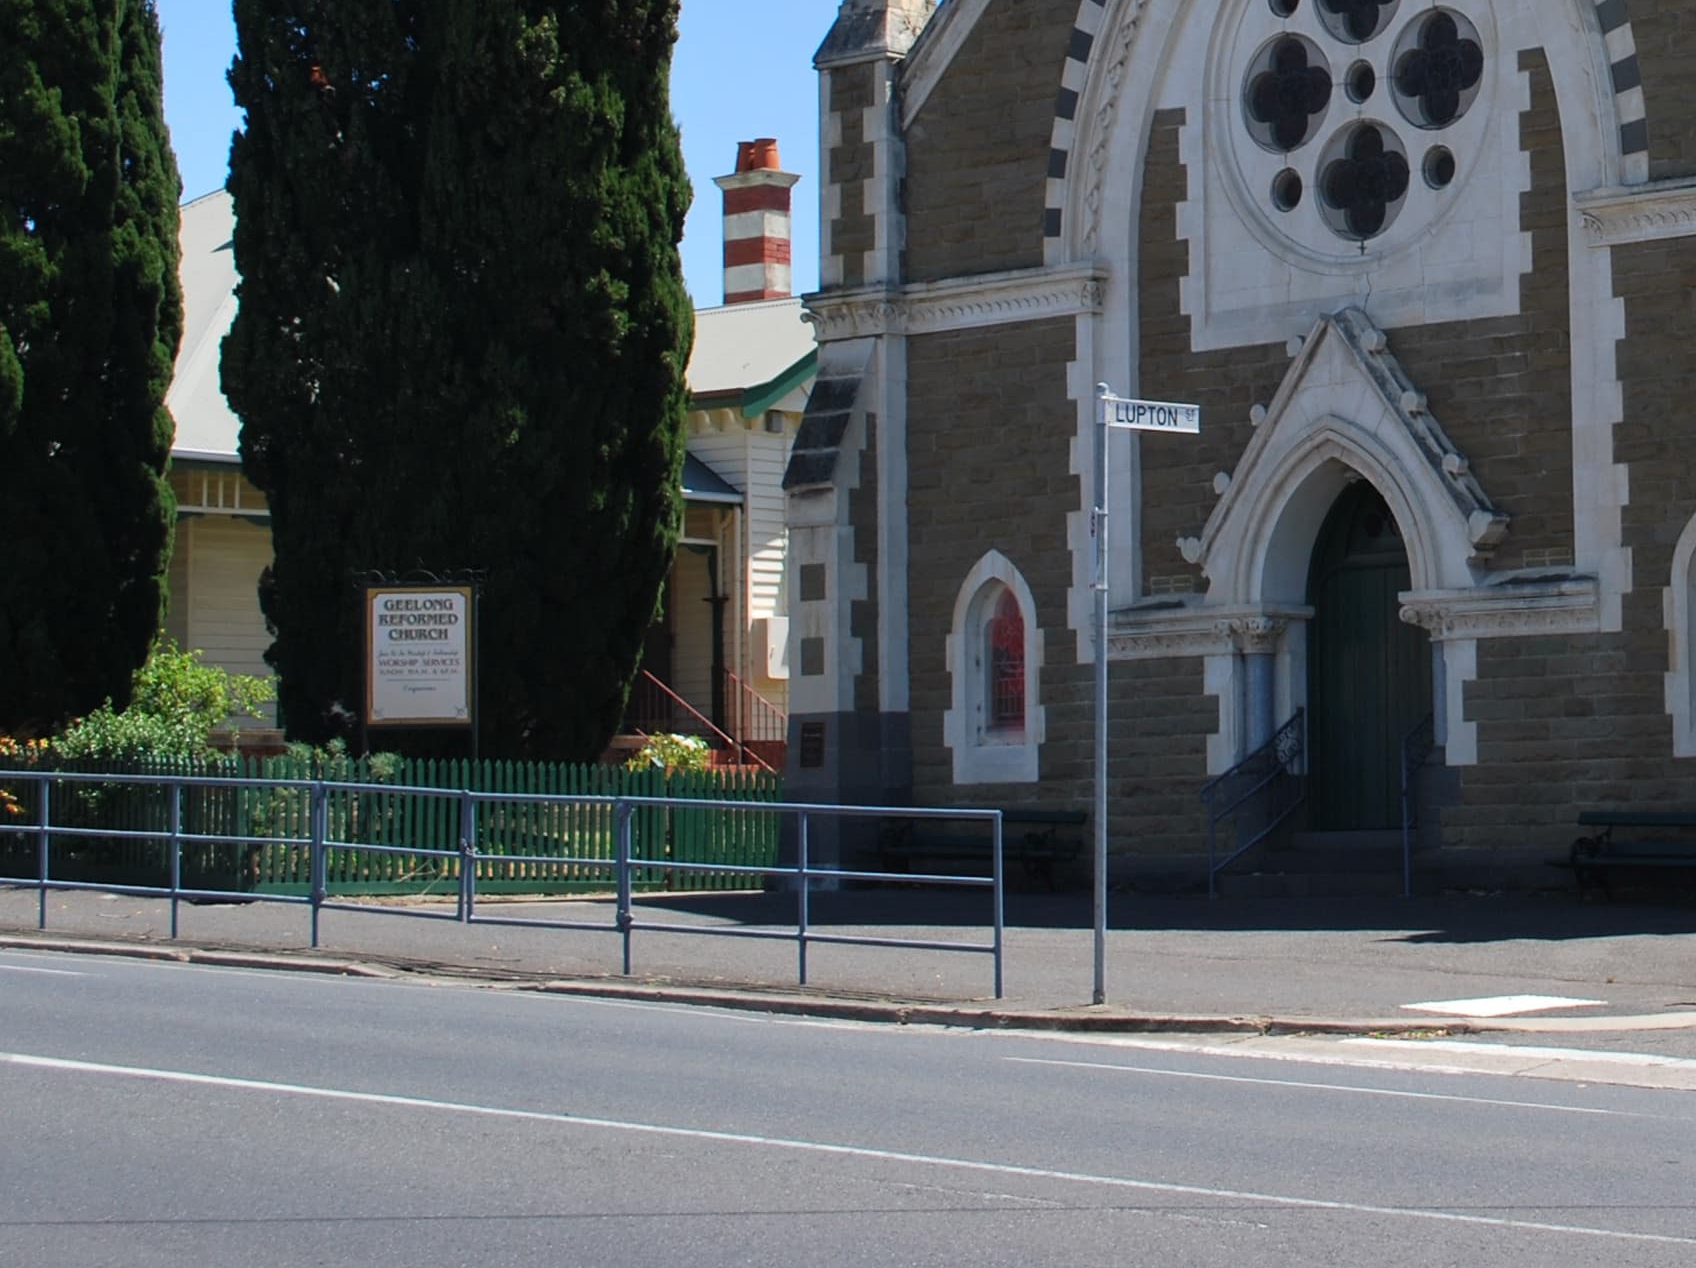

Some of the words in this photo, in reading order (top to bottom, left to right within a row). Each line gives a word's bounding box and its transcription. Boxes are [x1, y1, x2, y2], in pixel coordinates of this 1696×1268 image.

[1116, 403, 1178, 426] LUPTON
[1185, 408, 1195, 421] ST
[384, 599, 453, 611] GEELONG
[379, 613, 458, 625] REFORMED
[388, 628, 448, 640] CHURCH
[423, 658, 460, 666] SERVICES
